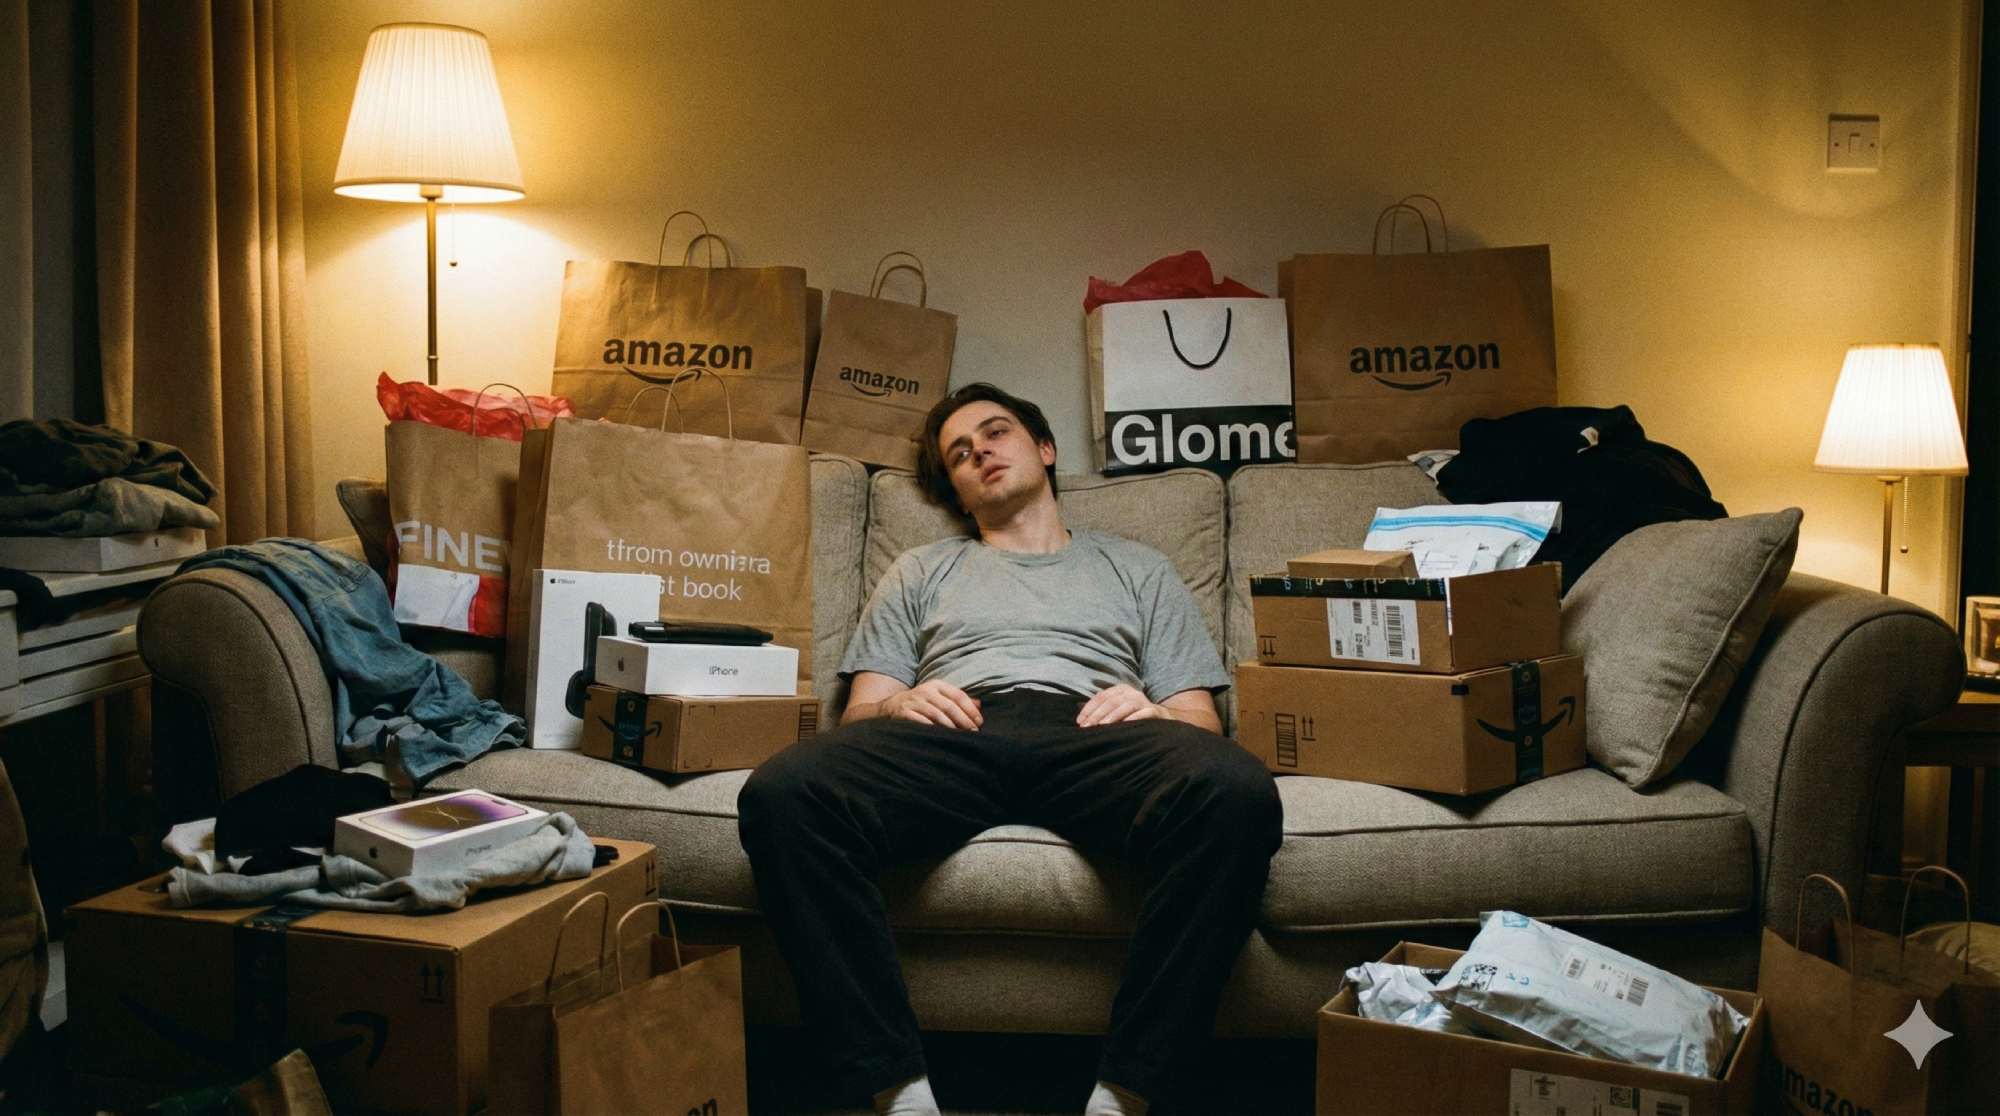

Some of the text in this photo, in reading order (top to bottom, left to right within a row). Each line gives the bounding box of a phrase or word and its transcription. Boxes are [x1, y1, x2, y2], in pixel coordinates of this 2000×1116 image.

[603, 338, 753, 370] amazon
[1350, 342, 1500, 374] amazon
[840, 366, 920, 395] amazon
[683, 576, 743, 601] book
